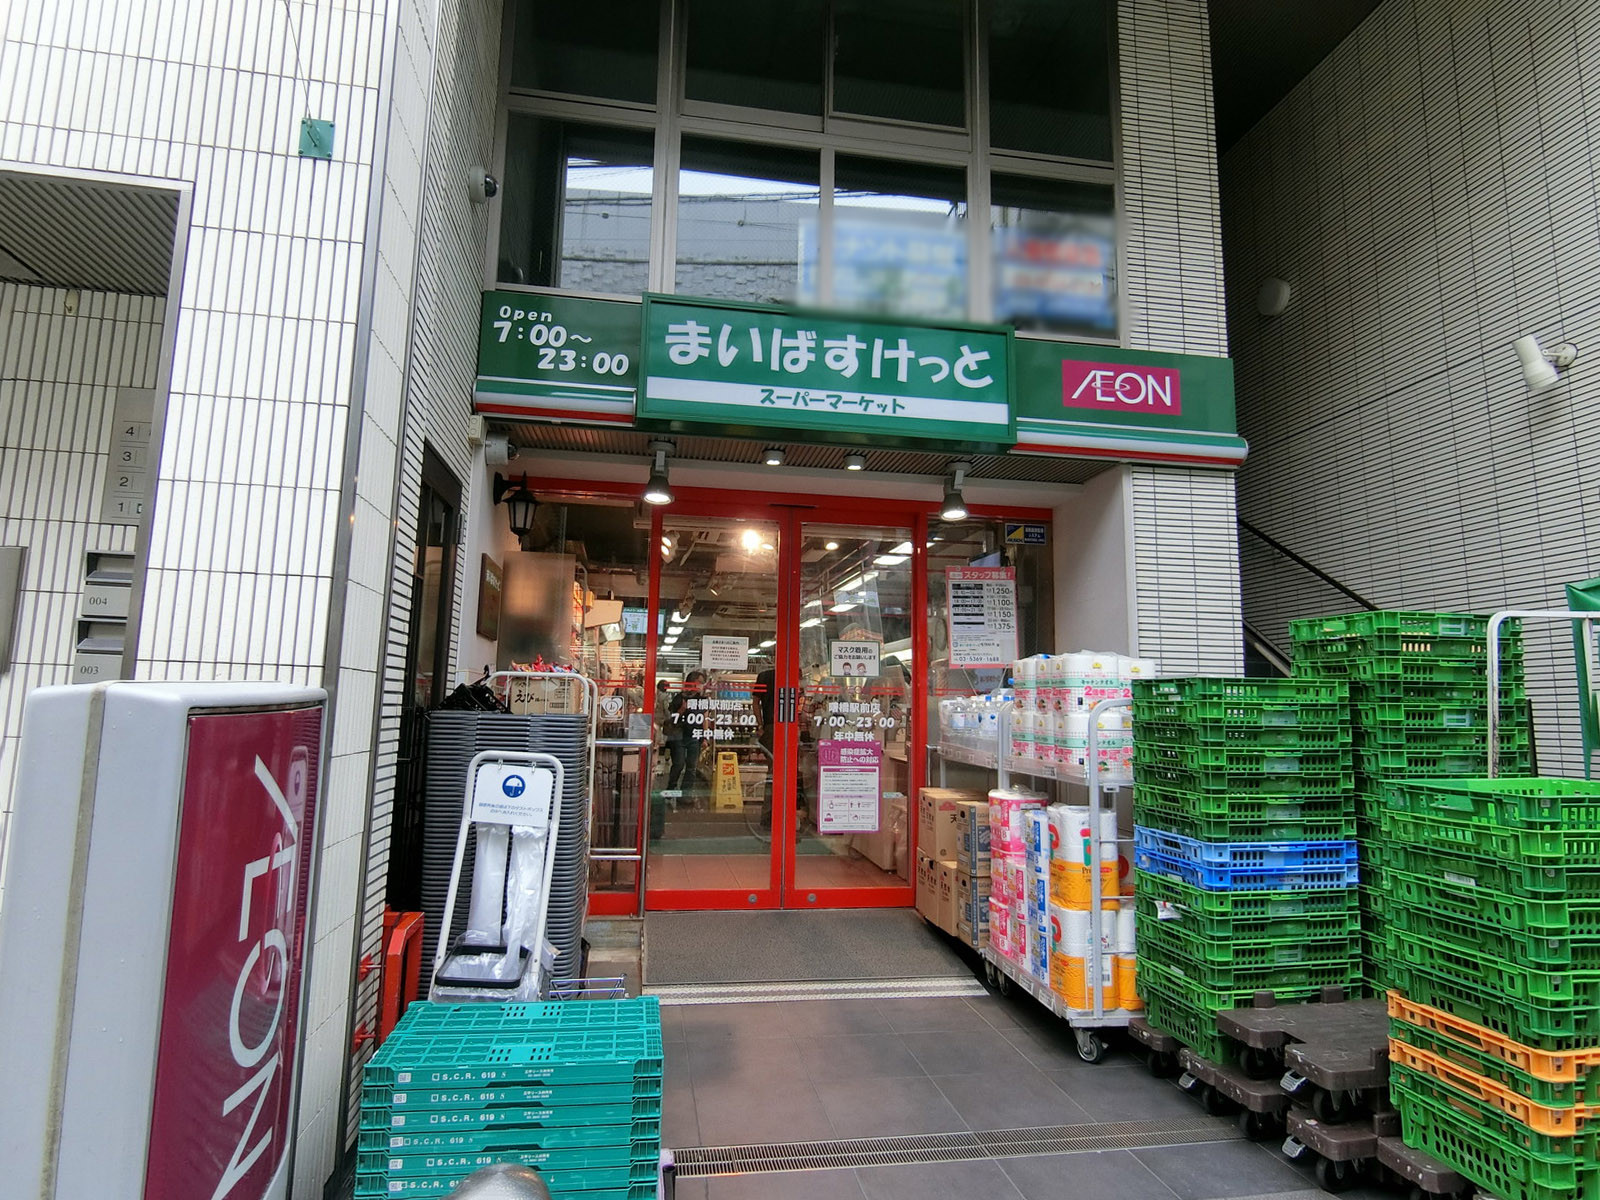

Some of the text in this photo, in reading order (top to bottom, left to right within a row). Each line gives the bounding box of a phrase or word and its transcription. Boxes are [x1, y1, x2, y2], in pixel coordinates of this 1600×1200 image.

[499, 305, 553, 322] Open
[664, 319, 994, 389] まいばすけっと
[537, 348, 630, 376] 23:00
[759, 388, 905, 415] スーパーマーケット
[125, 426, 135, 436] 4
[122, 451, 132, 461] 3
[119, 476, 129, 487] 2
[117, 502, 125, 512] 1
[89, 597, 108, 606] 004
[79, 665, 99, 675] 003
[691, 728, 735, 740] 年中無休
[833, 731, 875, 742] 年中無休
